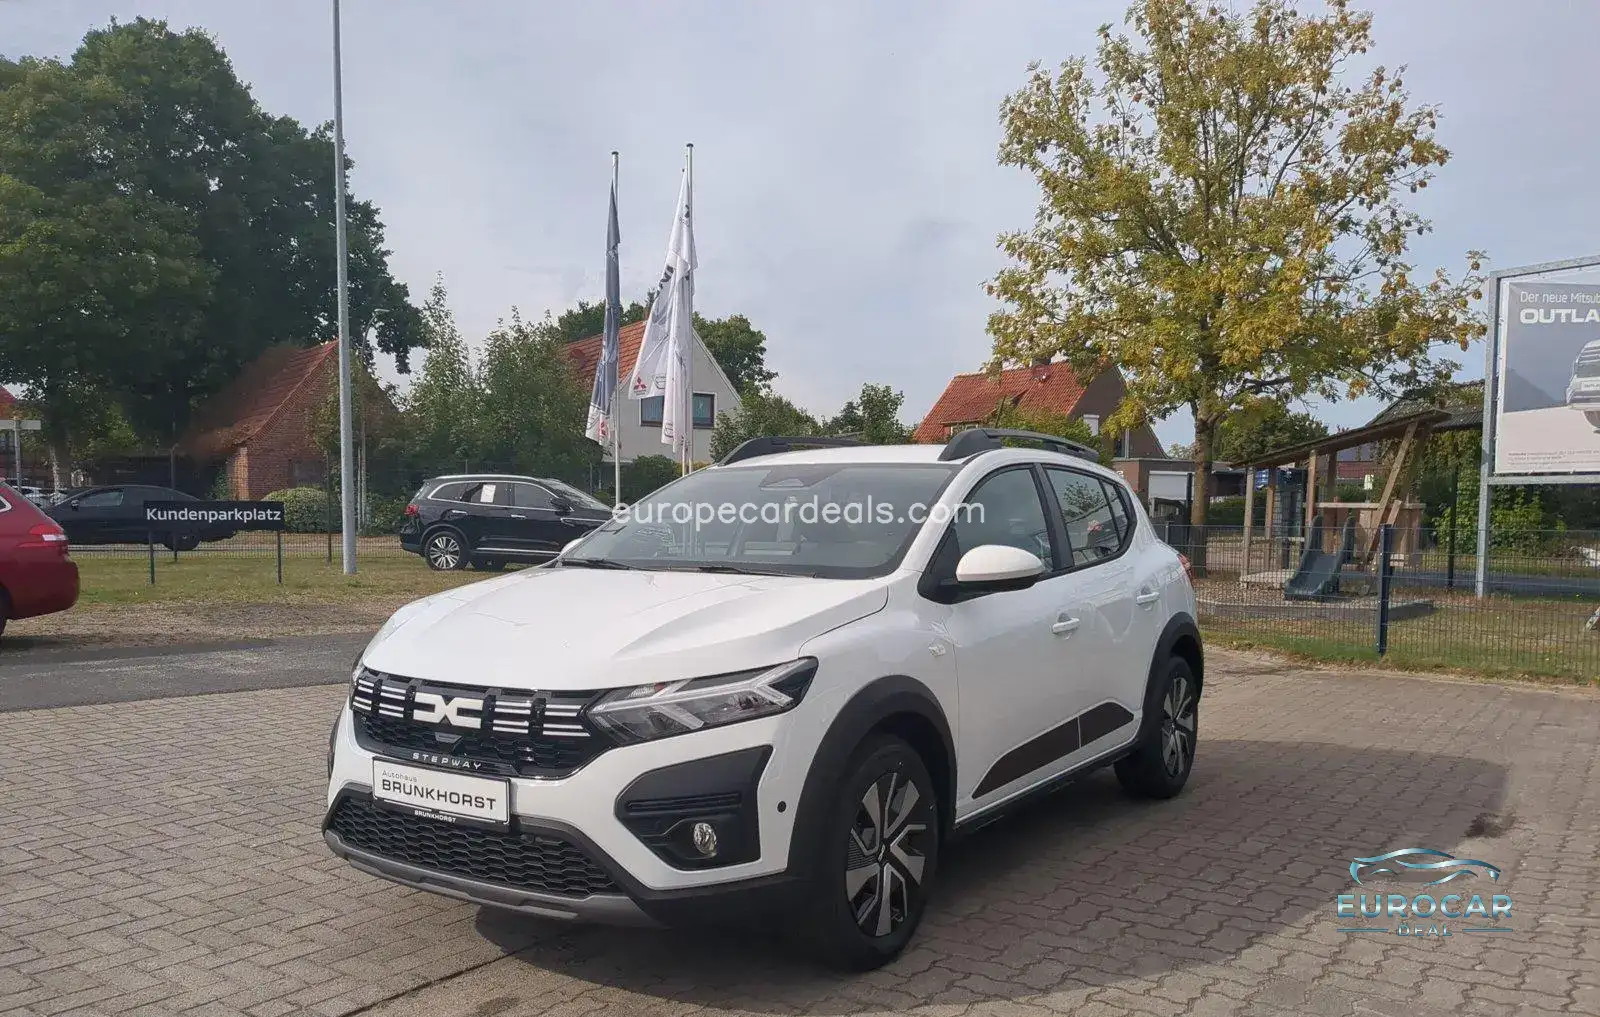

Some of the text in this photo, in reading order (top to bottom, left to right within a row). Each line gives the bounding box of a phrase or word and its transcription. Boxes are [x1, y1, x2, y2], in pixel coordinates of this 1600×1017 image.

[1520, 291, 1540, 303] Der
[1542, 293, 1568, 304] neue
[1520, 308, 1600, 324] OUTLA
[146, 508, 281, 523] Kundenparkplatz
[412, 752, 482, 770] STEPWAY
[381, 769, 418, 783] Autohaus
[381, 778, 497, 810] BRUNKHORST
[414, 809, 457, 824] BRUNKHORST
